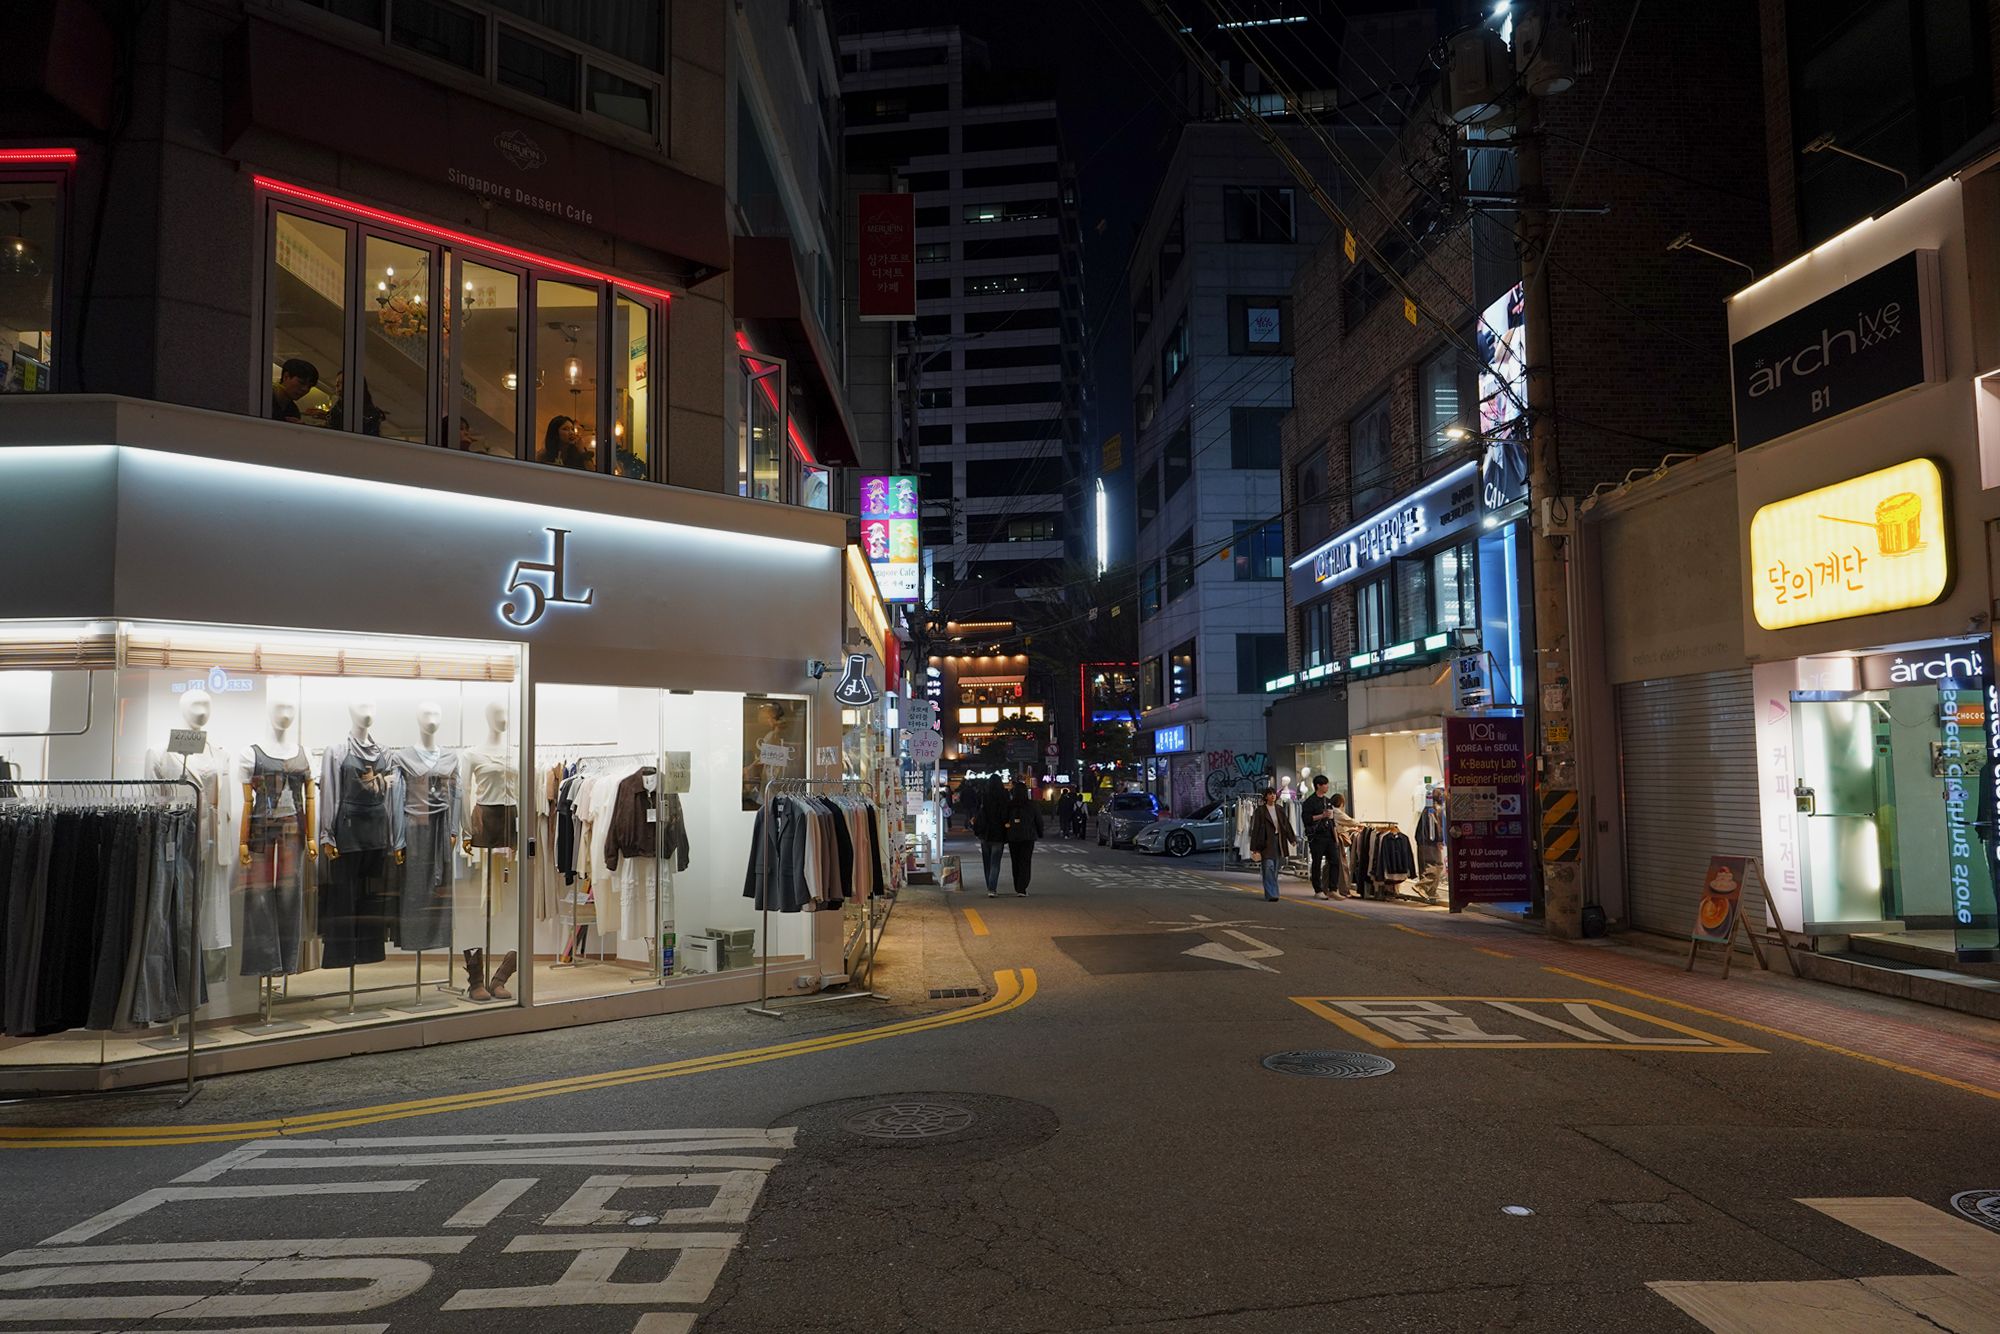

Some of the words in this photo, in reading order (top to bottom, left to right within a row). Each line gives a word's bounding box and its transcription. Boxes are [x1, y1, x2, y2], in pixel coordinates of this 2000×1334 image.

[448, 167, 512, 199] Singapore
[515, 188, 562, 215] Dessert
[566, 205, 593, 224] Cafe
[1811, 385, 1830, 413] B1
[844, 680, 861, 696] 5L
[1469, 723, 1495, 740] VOG
[1456, 744, 1482, 752] KOREA
[1485, 744, 1492, 752] in
[1493, 744, 1519, 752] SEOUL
[1501, 759, 1516, 769] Lab
[1453, 773, 1492, 785] Foreigner
[1493, 772, 1525, 785] Friendly
[1484, 849, 1508, 857] Lounge
[1500, 861, 1523, 869] Lounge
[1470, 873, 1502, 881] Reception
[1503, 873, 1527, 881] Lounge
